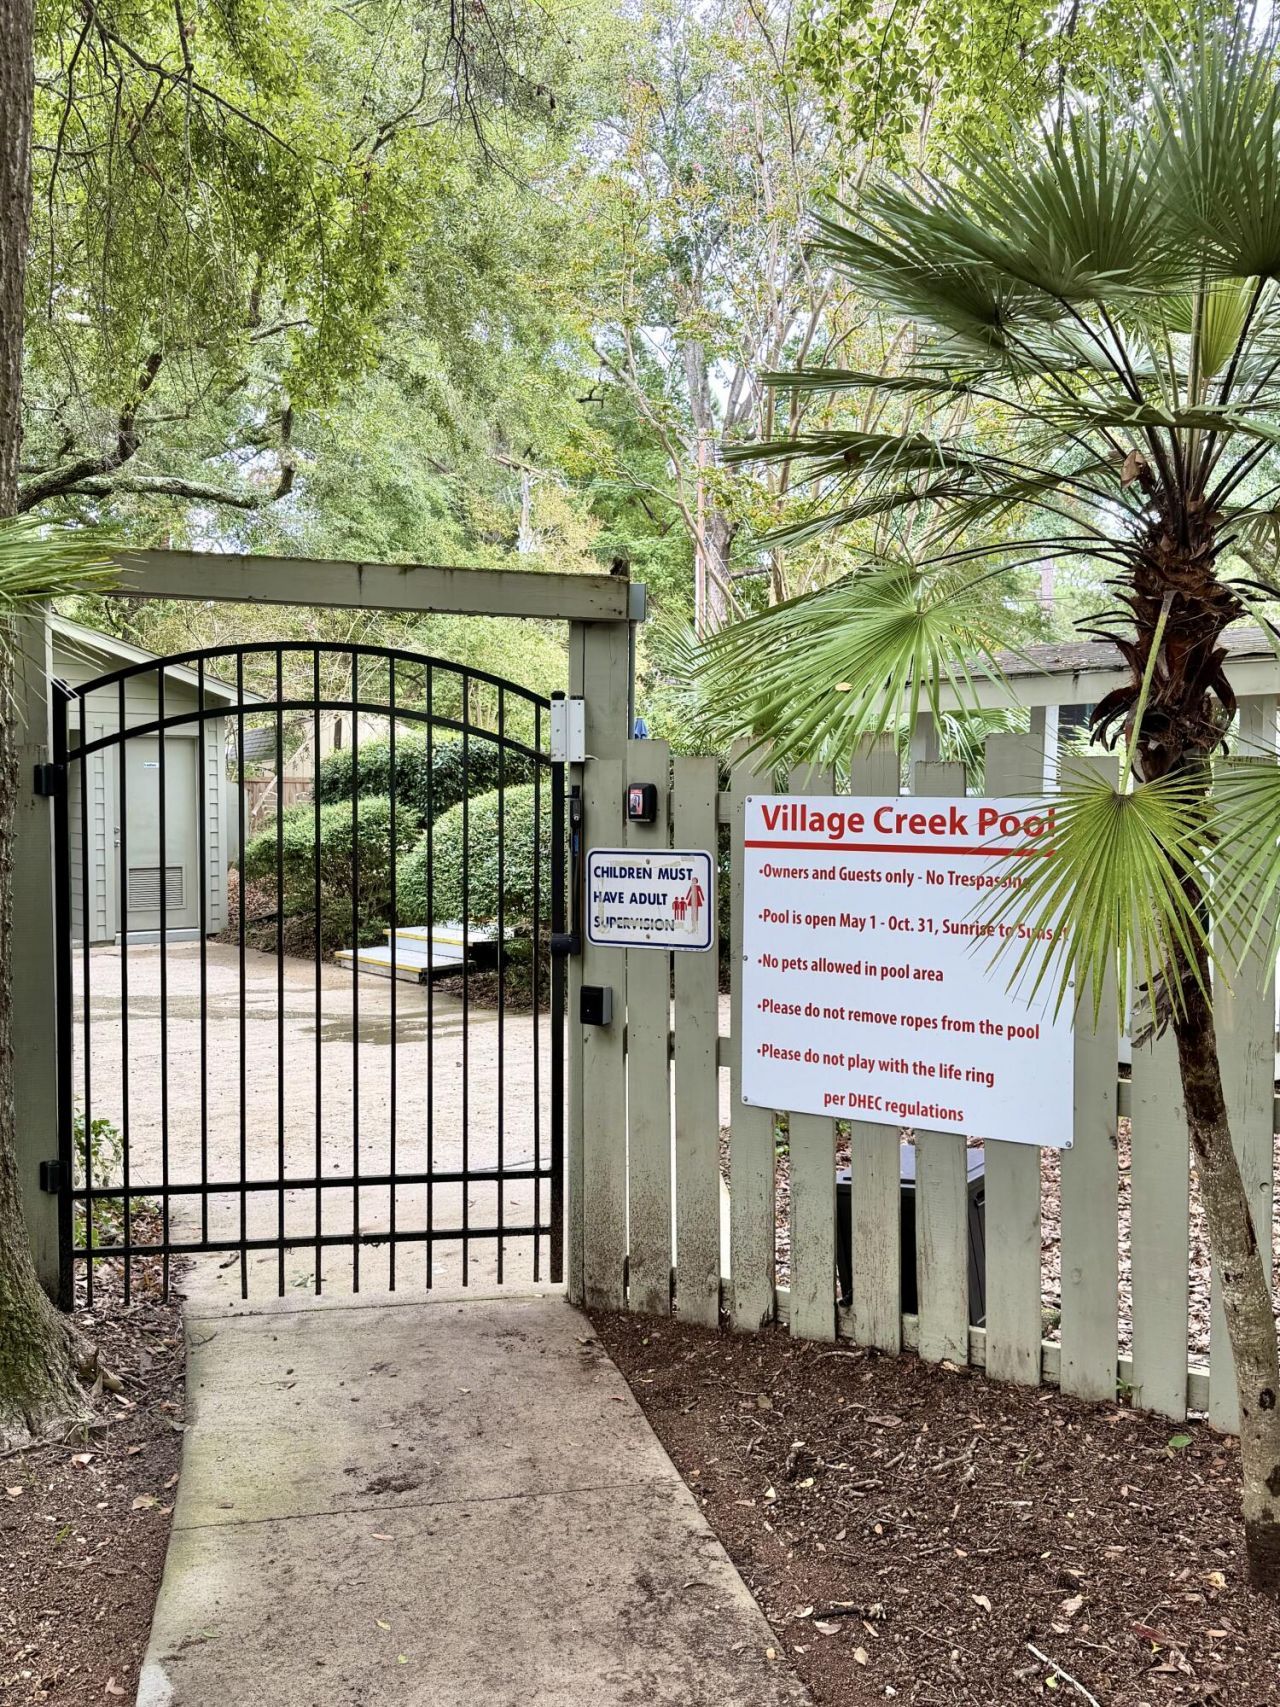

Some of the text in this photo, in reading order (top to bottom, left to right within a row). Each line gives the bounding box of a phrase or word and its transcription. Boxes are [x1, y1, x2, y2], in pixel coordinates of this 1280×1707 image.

[761, 804, 865, 840] Village
[873, 806, 968, 836] Creek
[594, 866, 693, 880] CHILDREN MUST
[762, 864, 808, 879] Owners
[812, 867, 836, 880] and
[839, 867, 882, 881] Guests
[885, 869, 915, 887] only
[926, 872, 945, 885] No
[947, 870, 1031, 892] Trespassin
[593, 891, 668, 906] HAVE ADULT
[594, 916, 675, 932] SUPERVISION
[762, 909, 789, 924] Pool
[792, 913, 801, 924] is
[805, 915, 836, 928] open
[839, 913, 867, 931] May
[870, 916, 875, 928] 1
[887, 915, 916, 931] Oct.
[918, 918, 939, 937] 31,
[942, 919, 995, 937] Sunrise
[762, 953, 944, 981] No pets allowed in pool area
[762, 998, 1039, 1040] Please do not remove ropes from the pool
[762, 1044, 994, 1088] Please do not play with the life ring
[824, 1092, 964, 1120] per DHEC regulations
